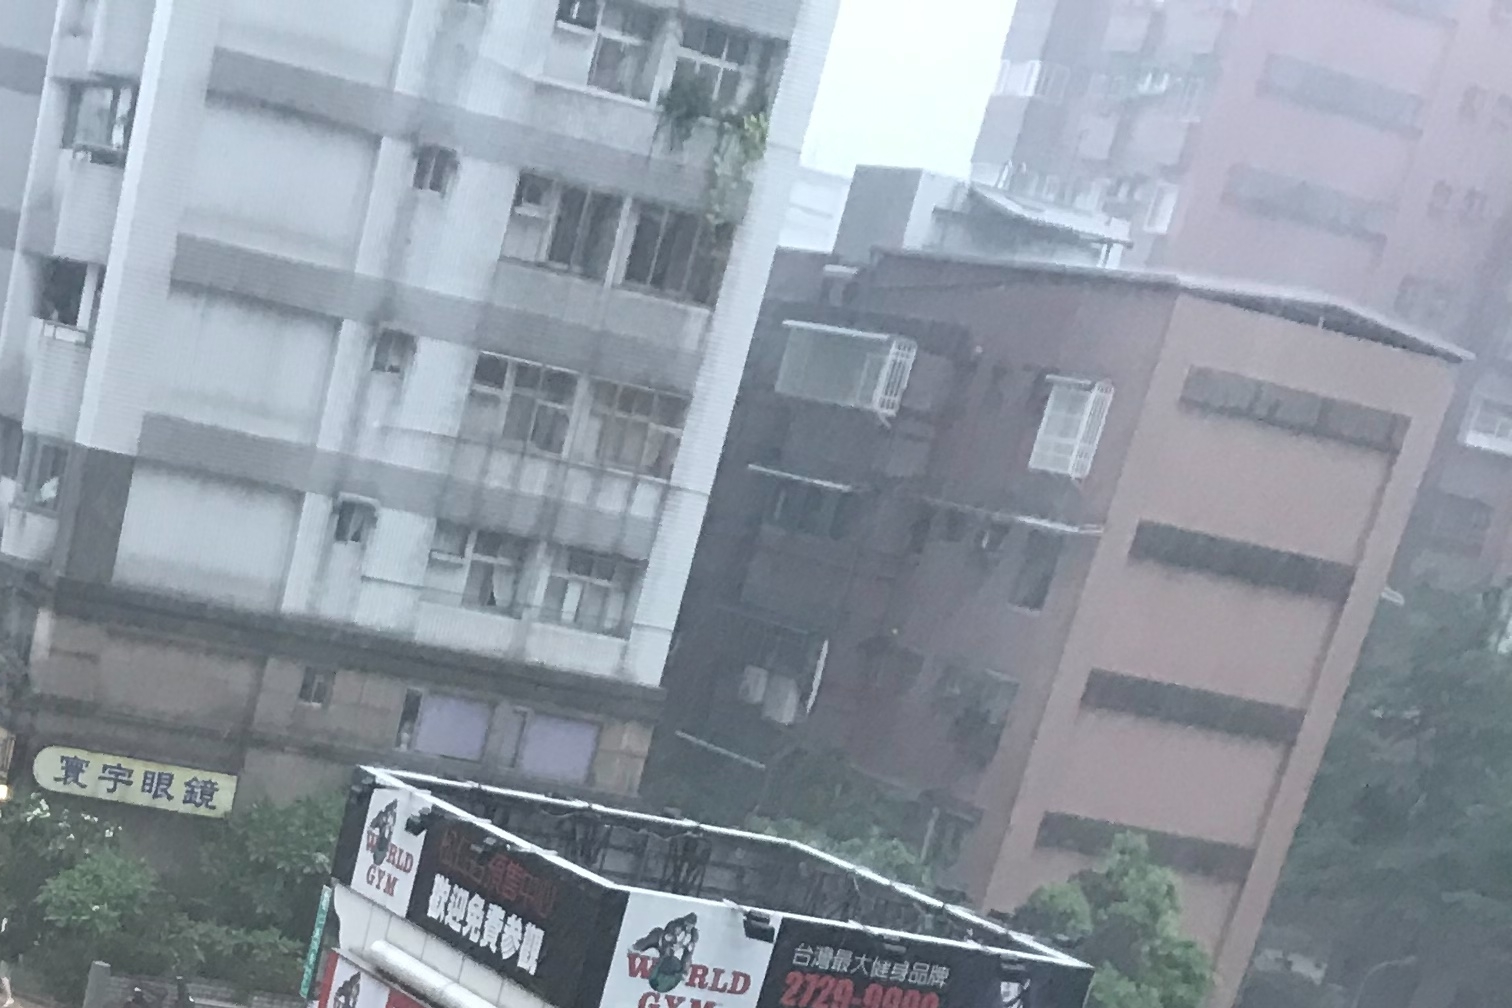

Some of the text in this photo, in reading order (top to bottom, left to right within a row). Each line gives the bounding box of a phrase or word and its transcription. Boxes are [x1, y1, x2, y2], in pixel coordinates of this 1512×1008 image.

[53, 754, 220, 810] 寰宇眼鏡
[366, 829, 414, 873] WORLD
[366, 863, 399, 897] GYM
[627, 952, 751, 994] WORLD
[792, 943, 950, 988] 台灣最大健身品牌
